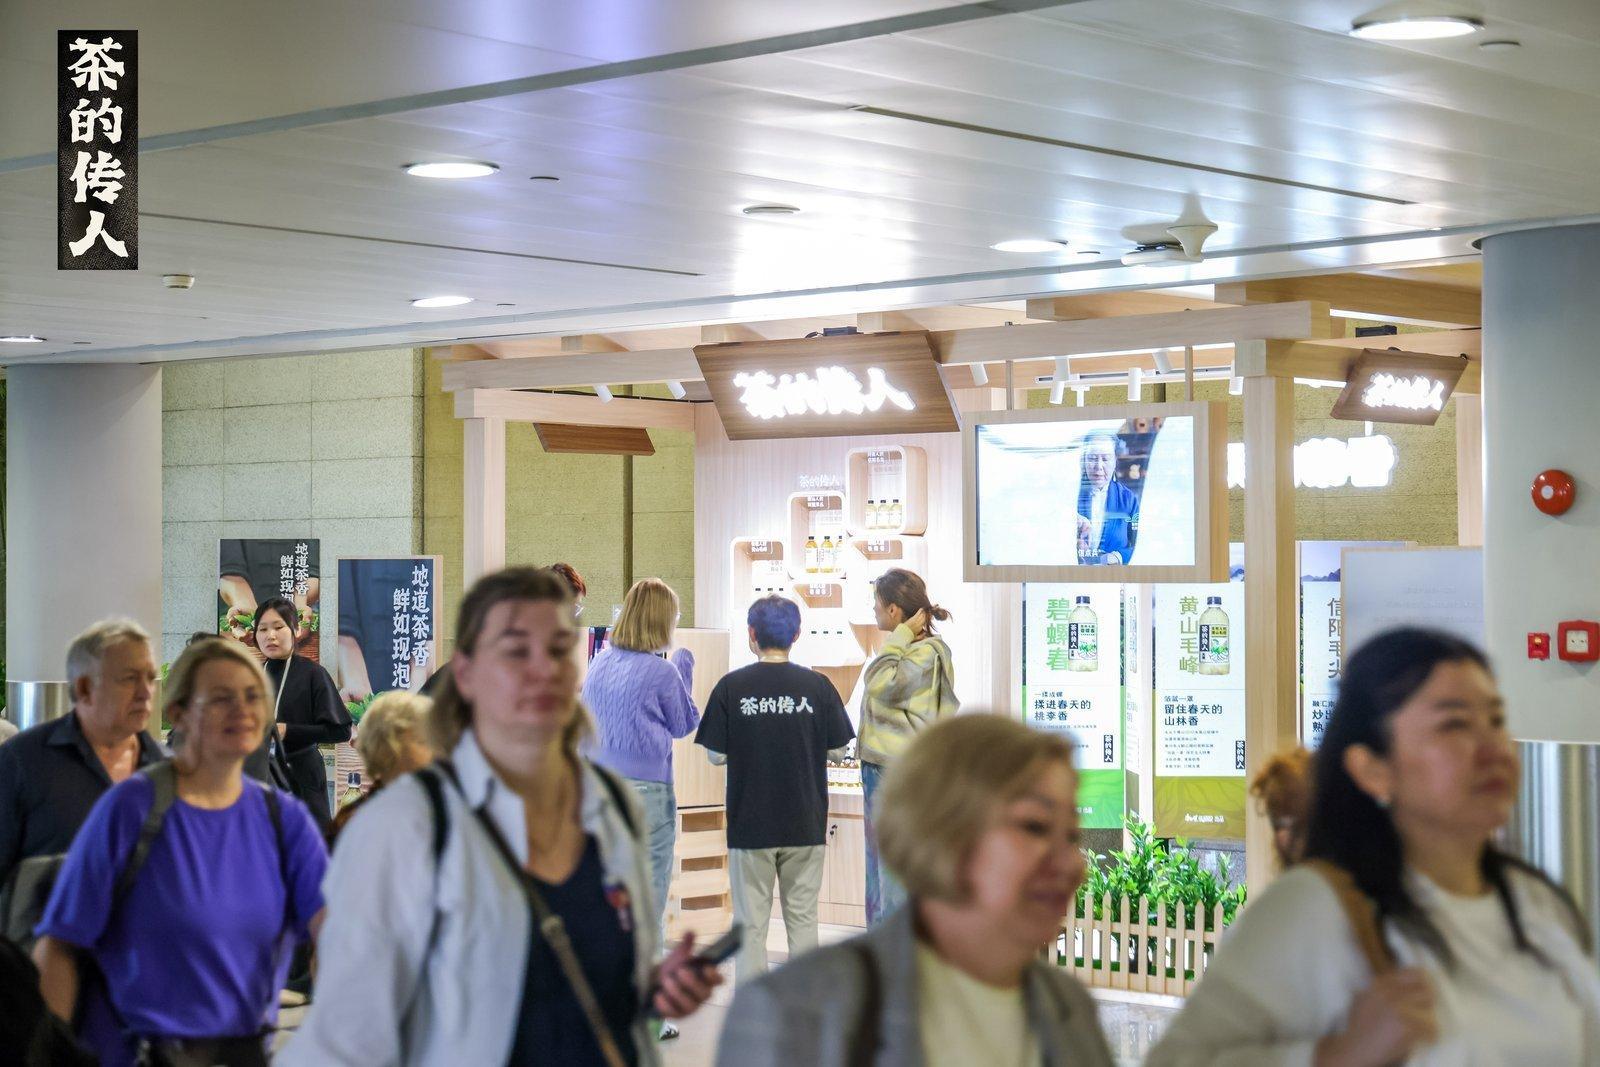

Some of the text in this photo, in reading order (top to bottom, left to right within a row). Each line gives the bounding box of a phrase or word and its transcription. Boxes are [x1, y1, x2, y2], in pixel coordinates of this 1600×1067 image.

[295, 543, 309, 596] 地道茶香
[392, 588, 410, 689] 鲜如现泡
[412, 563, 430, 667] 地道茶香
[1046, 597, 1071, 671] 碧螺春
[1179, 596, 1199, 675] 黄山毛峰
[740, 696, 813, 715] 茶的传人
[1034, 699, 1091, 710] 揉进春天的
[1165, 704, 1223, 714] 留住春天的
[1165, 716, 1199, 727] 山林香
